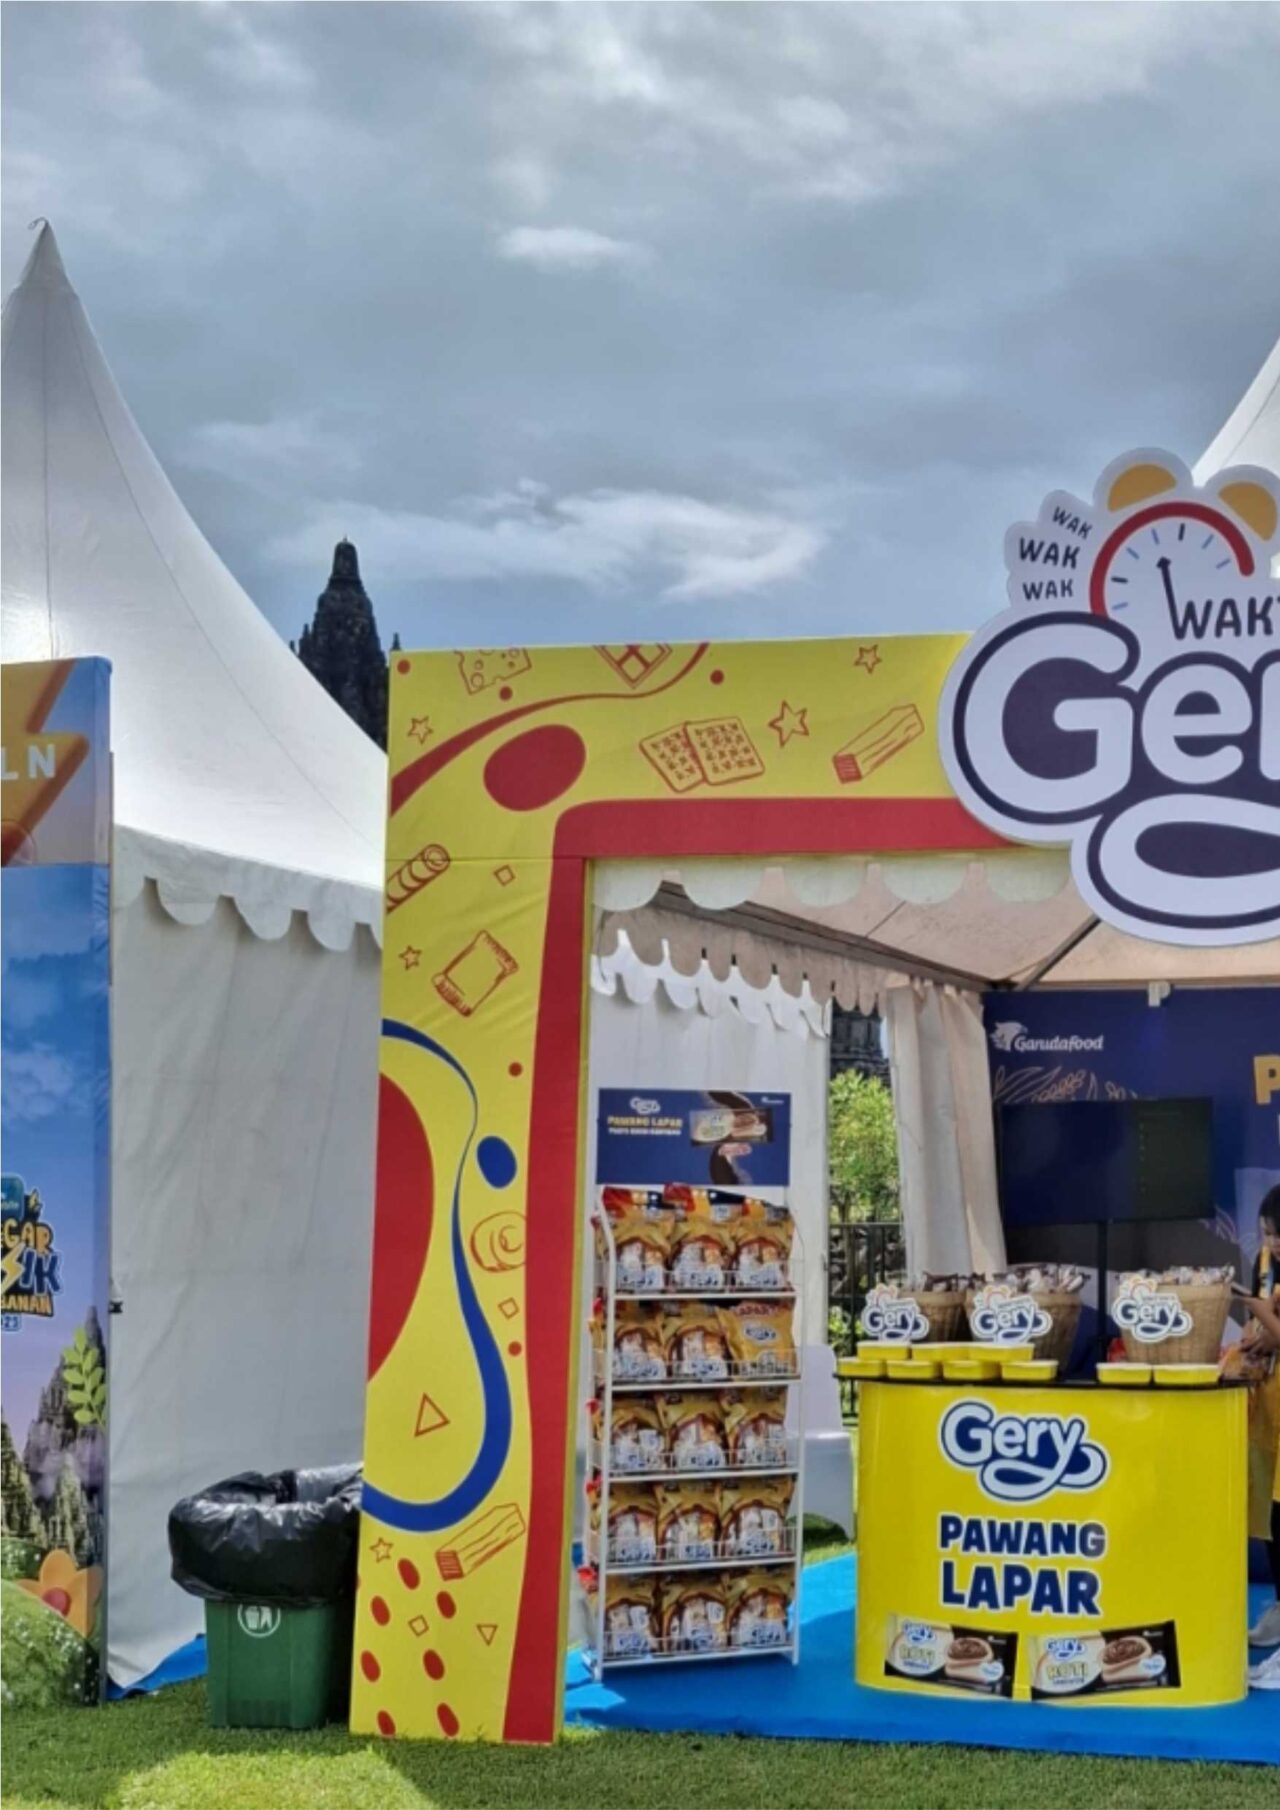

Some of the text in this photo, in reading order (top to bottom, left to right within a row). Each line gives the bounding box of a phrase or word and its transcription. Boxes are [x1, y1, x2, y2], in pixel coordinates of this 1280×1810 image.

[1052, 505, 1093, 540] WAK
[1019, 537, 1080, 569] WAK
[1022, 578, 1074, 602] WAK
[1014, 1034, 1104, 1052] Garudafood
[1, 1218, 51, 1257] GAR
[862, 1304, 928, 1341] Gery
[971, 1303, 1052, 1344] Gery
[1114, 1298, 1190, 1339] Gery
[941, 1401, 1107, 1500] Gery
[940, 1514, 1106, 1558] PAWANG
[942, 1561, 1101, 1616] LAPAR
